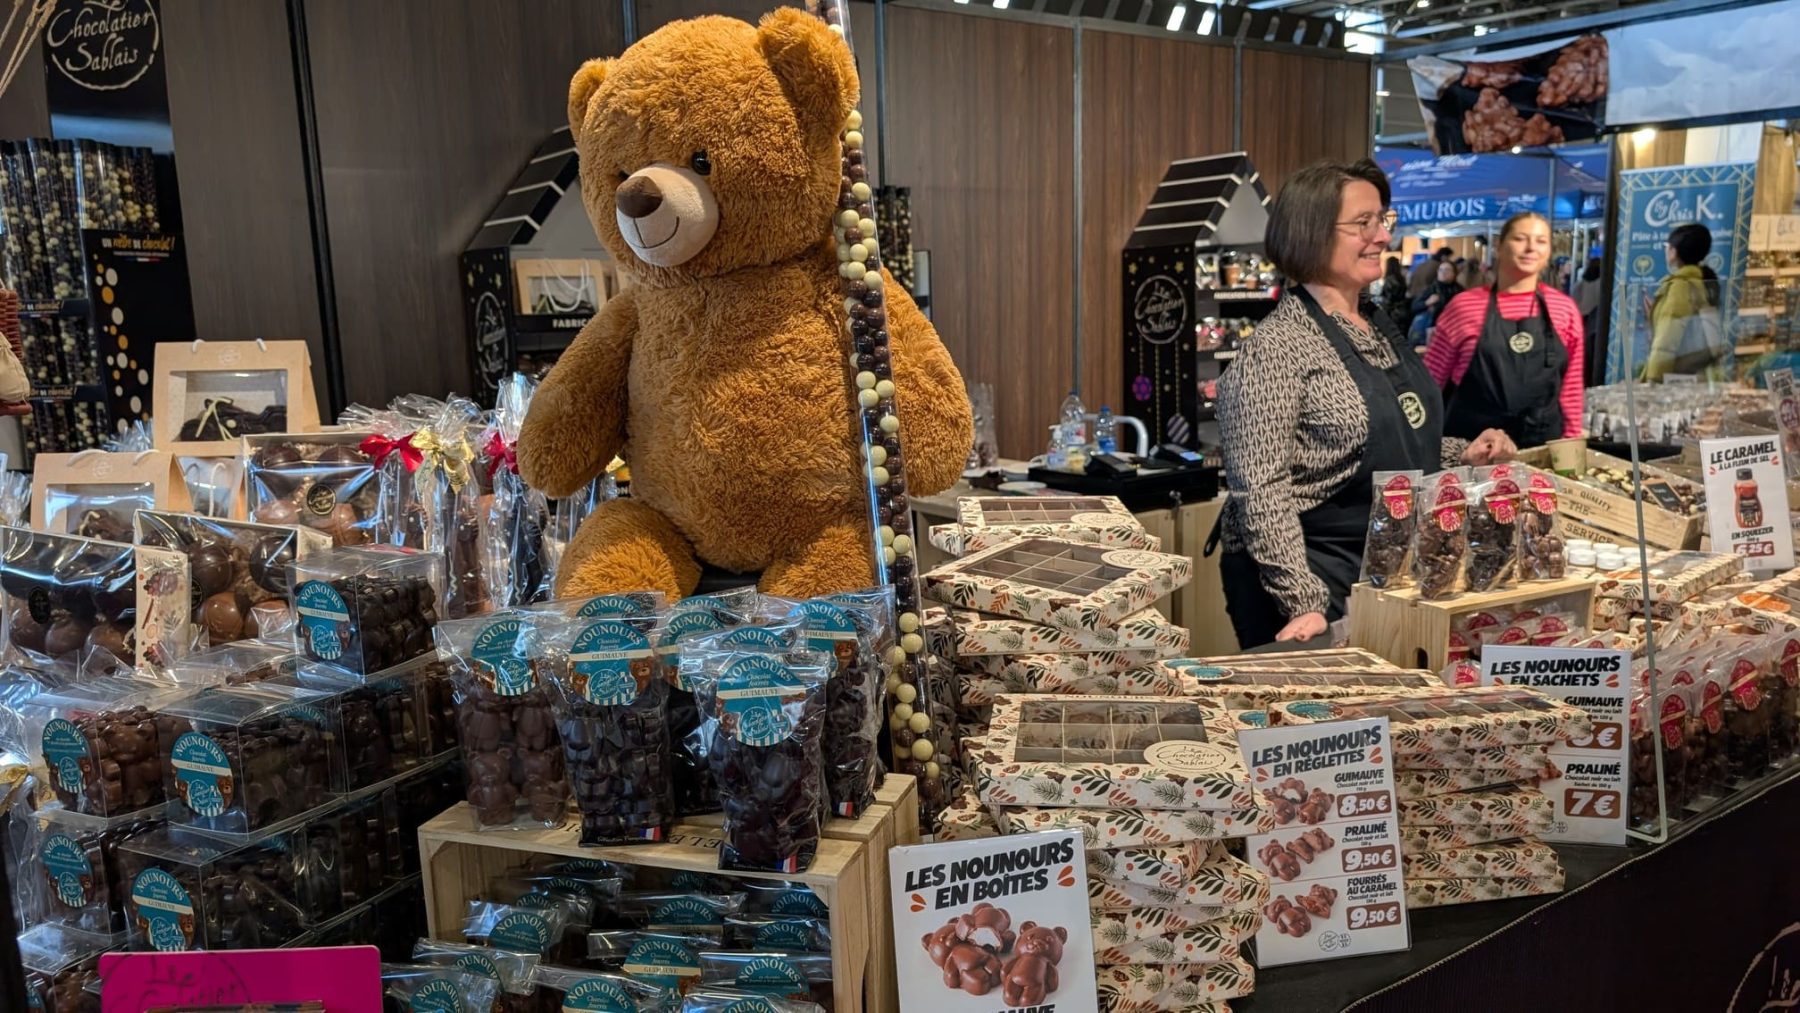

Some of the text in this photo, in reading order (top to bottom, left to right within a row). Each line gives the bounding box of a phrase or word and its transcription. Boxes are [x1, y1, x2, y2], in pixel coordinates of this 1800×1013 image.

[47, 1, 152, 47] Chocolatier
[65, 33, 138, 71] Sablais
[1710, 441, 1776, 464] LE CARAMEL
[300, 584, 343, 609] NOUNOURS
[576, 624, 643, 650] NOUNOURS
[727, 659, 794, 687] NOUNOURS
[1490, 661, 1522, 676] LES
[1524, 655, 1621, 675] NOUNOURS
[1510, 673, 1600, 687] EN SACHETS
[1564, 696, 1624, 708] GUIMAUVE
[44, 721, 84, 745] NOUNOURS
[175, 735, 224, 763] NOUNOURS
[1252, 725, 1382, 767] LES NOUNOURS
[1273, 749, 1365, 778] EN RÉGLETTES
[1334, 769, 1384, 783] GUIMAUVE
[1565, 761, 1621, 776] PRALINÉ
[1336, 781, 1358, 789] Chocolat
[1344, 821, 1387, 837] PRALINÉ
[905, 838, 1074, 892] LES NOUNOURS
[136, 873, 185, 901] NOUNOURS
[935, 868, 1048, 910] EN BOÎTES
[1346, 882, 1397, 895] AU CARAMEL
[1347, 874, 1387, 887] FOURRÉS
[655, 899, 714, 922] NOUNOURS
[496, 914, 549, 945] NOUNOURS
[631, 940, 692, 963] NOUNOURS
[456, 954, 498, 979] OUNOUR
[739, 956, 801, 982] NOUNOURS
[568, 981, 631, 1009] NOUNOURS
